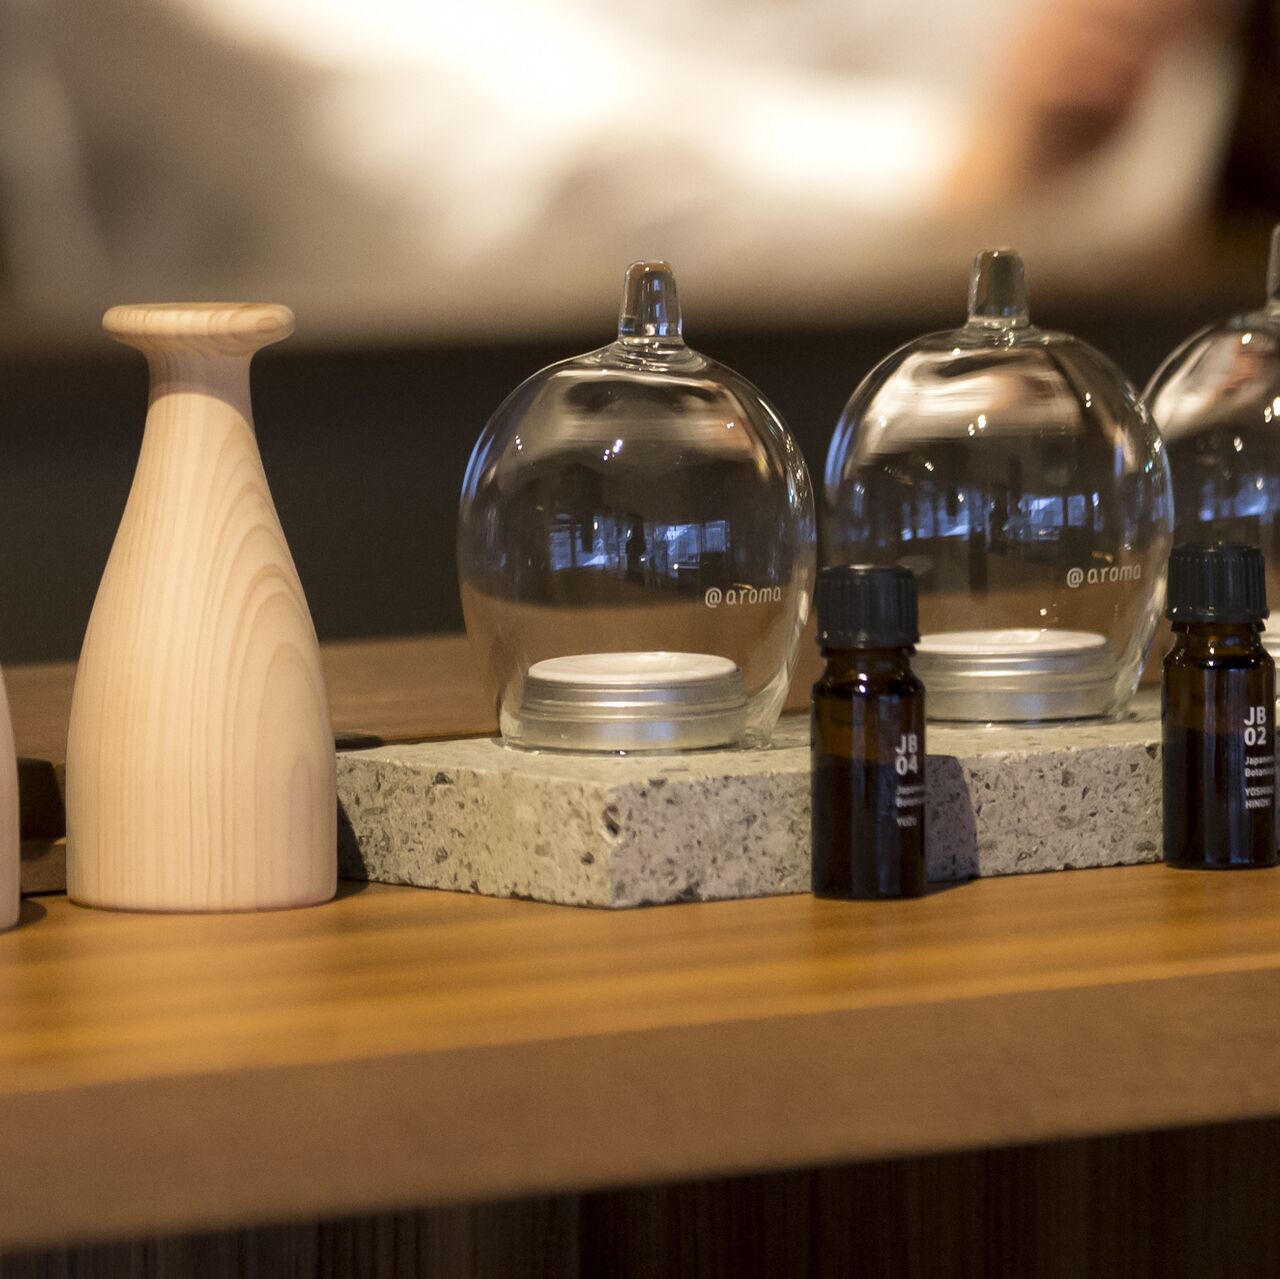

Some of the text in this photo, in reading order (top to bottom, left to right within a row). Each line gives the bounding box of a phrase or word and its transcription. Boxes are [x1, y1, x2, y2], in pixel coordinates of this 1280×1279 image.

[1066, 564, 1142, 589] @aroma
[704, 586, 782, 609] @aroma
[1244, 706, 1267, 726] JB
[895, 733, 919, 756] JB
[1244, 726, 1267, 747] 02
[895, 755, 919, 776] 04
